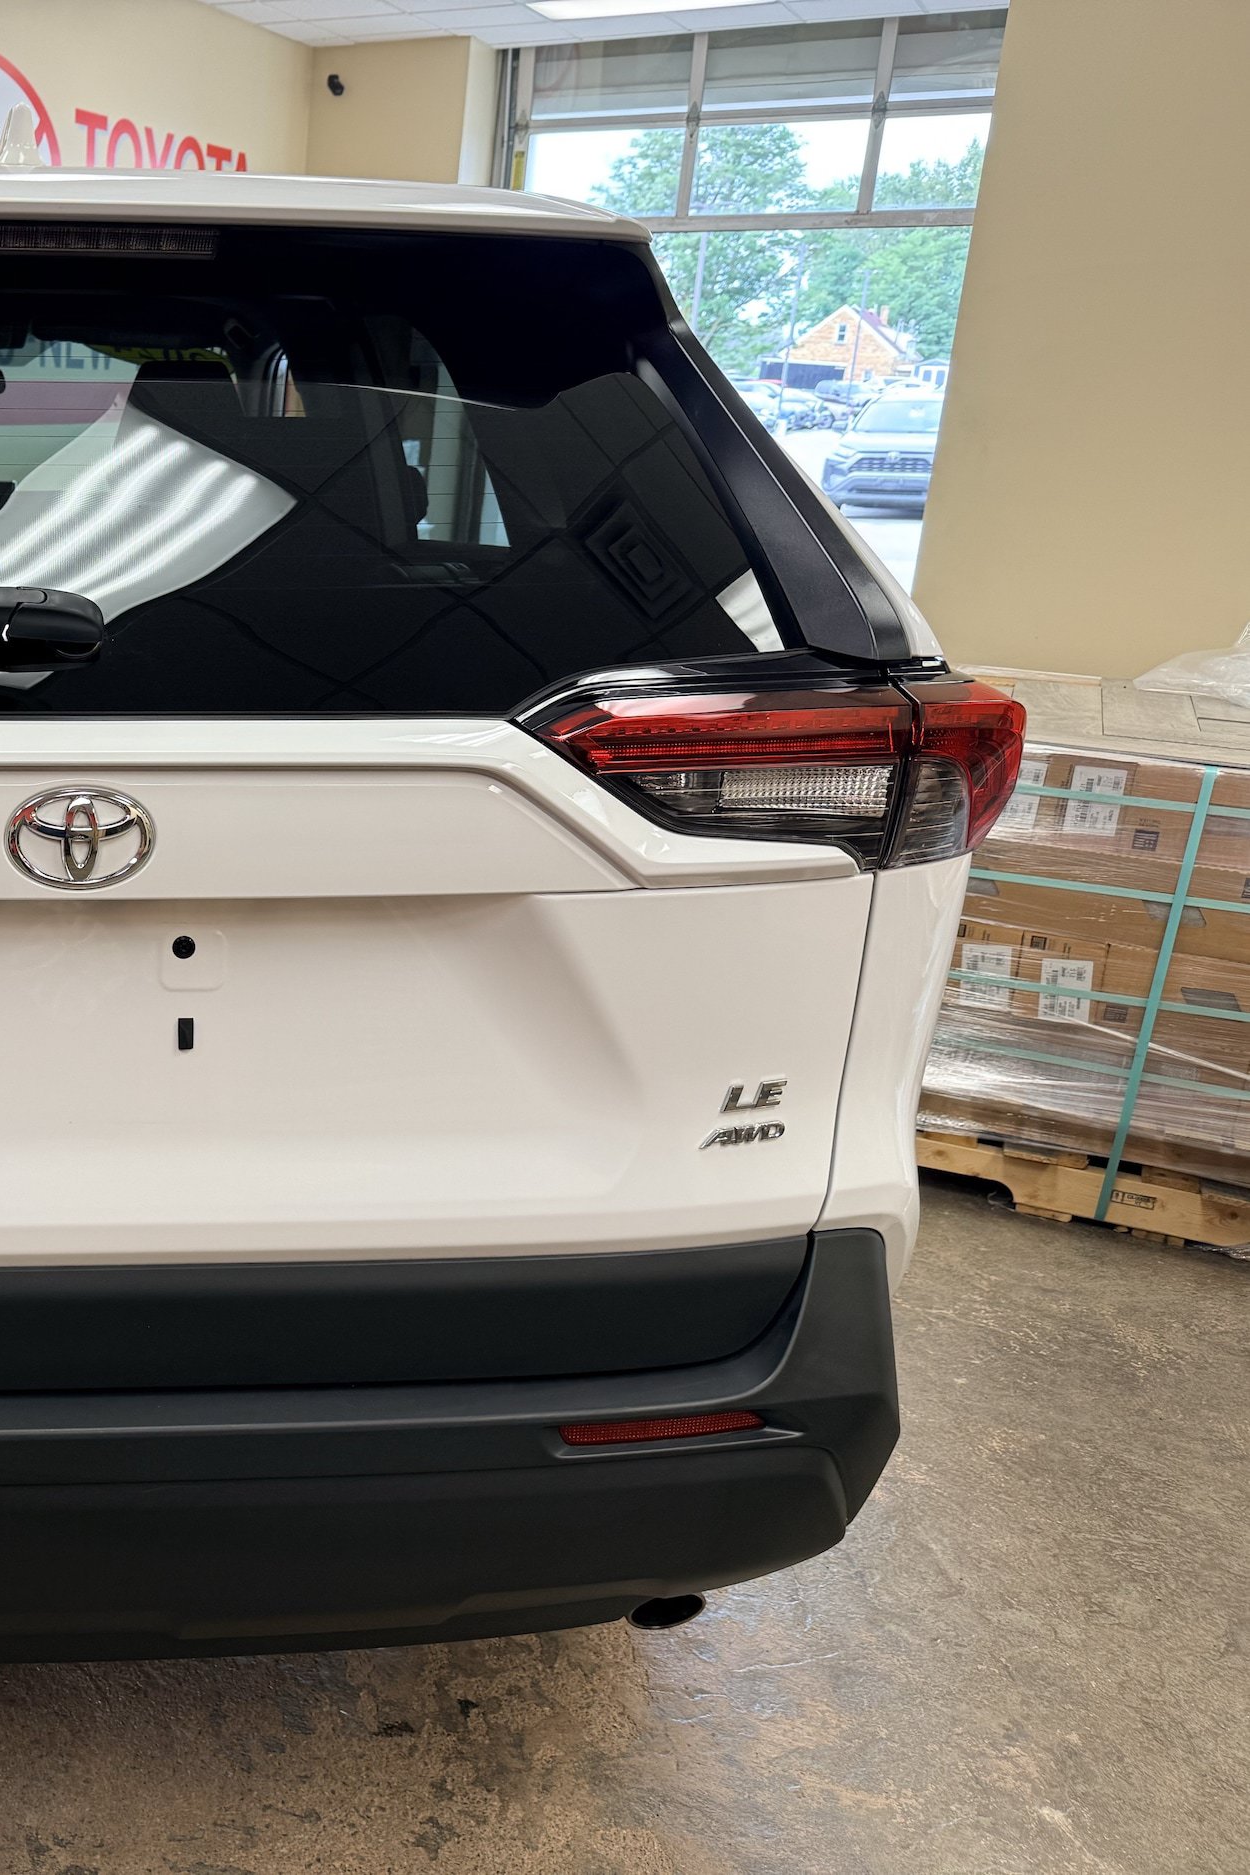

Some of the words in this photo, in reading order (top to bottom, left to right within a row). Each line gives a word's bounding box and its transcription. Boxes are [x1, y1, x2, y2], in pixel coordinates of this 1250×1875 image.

[75, 108, 248, 172] TOYO
[719, 1079, 788, 1114] LE
[698, 1120, 786, 1150] AWD
